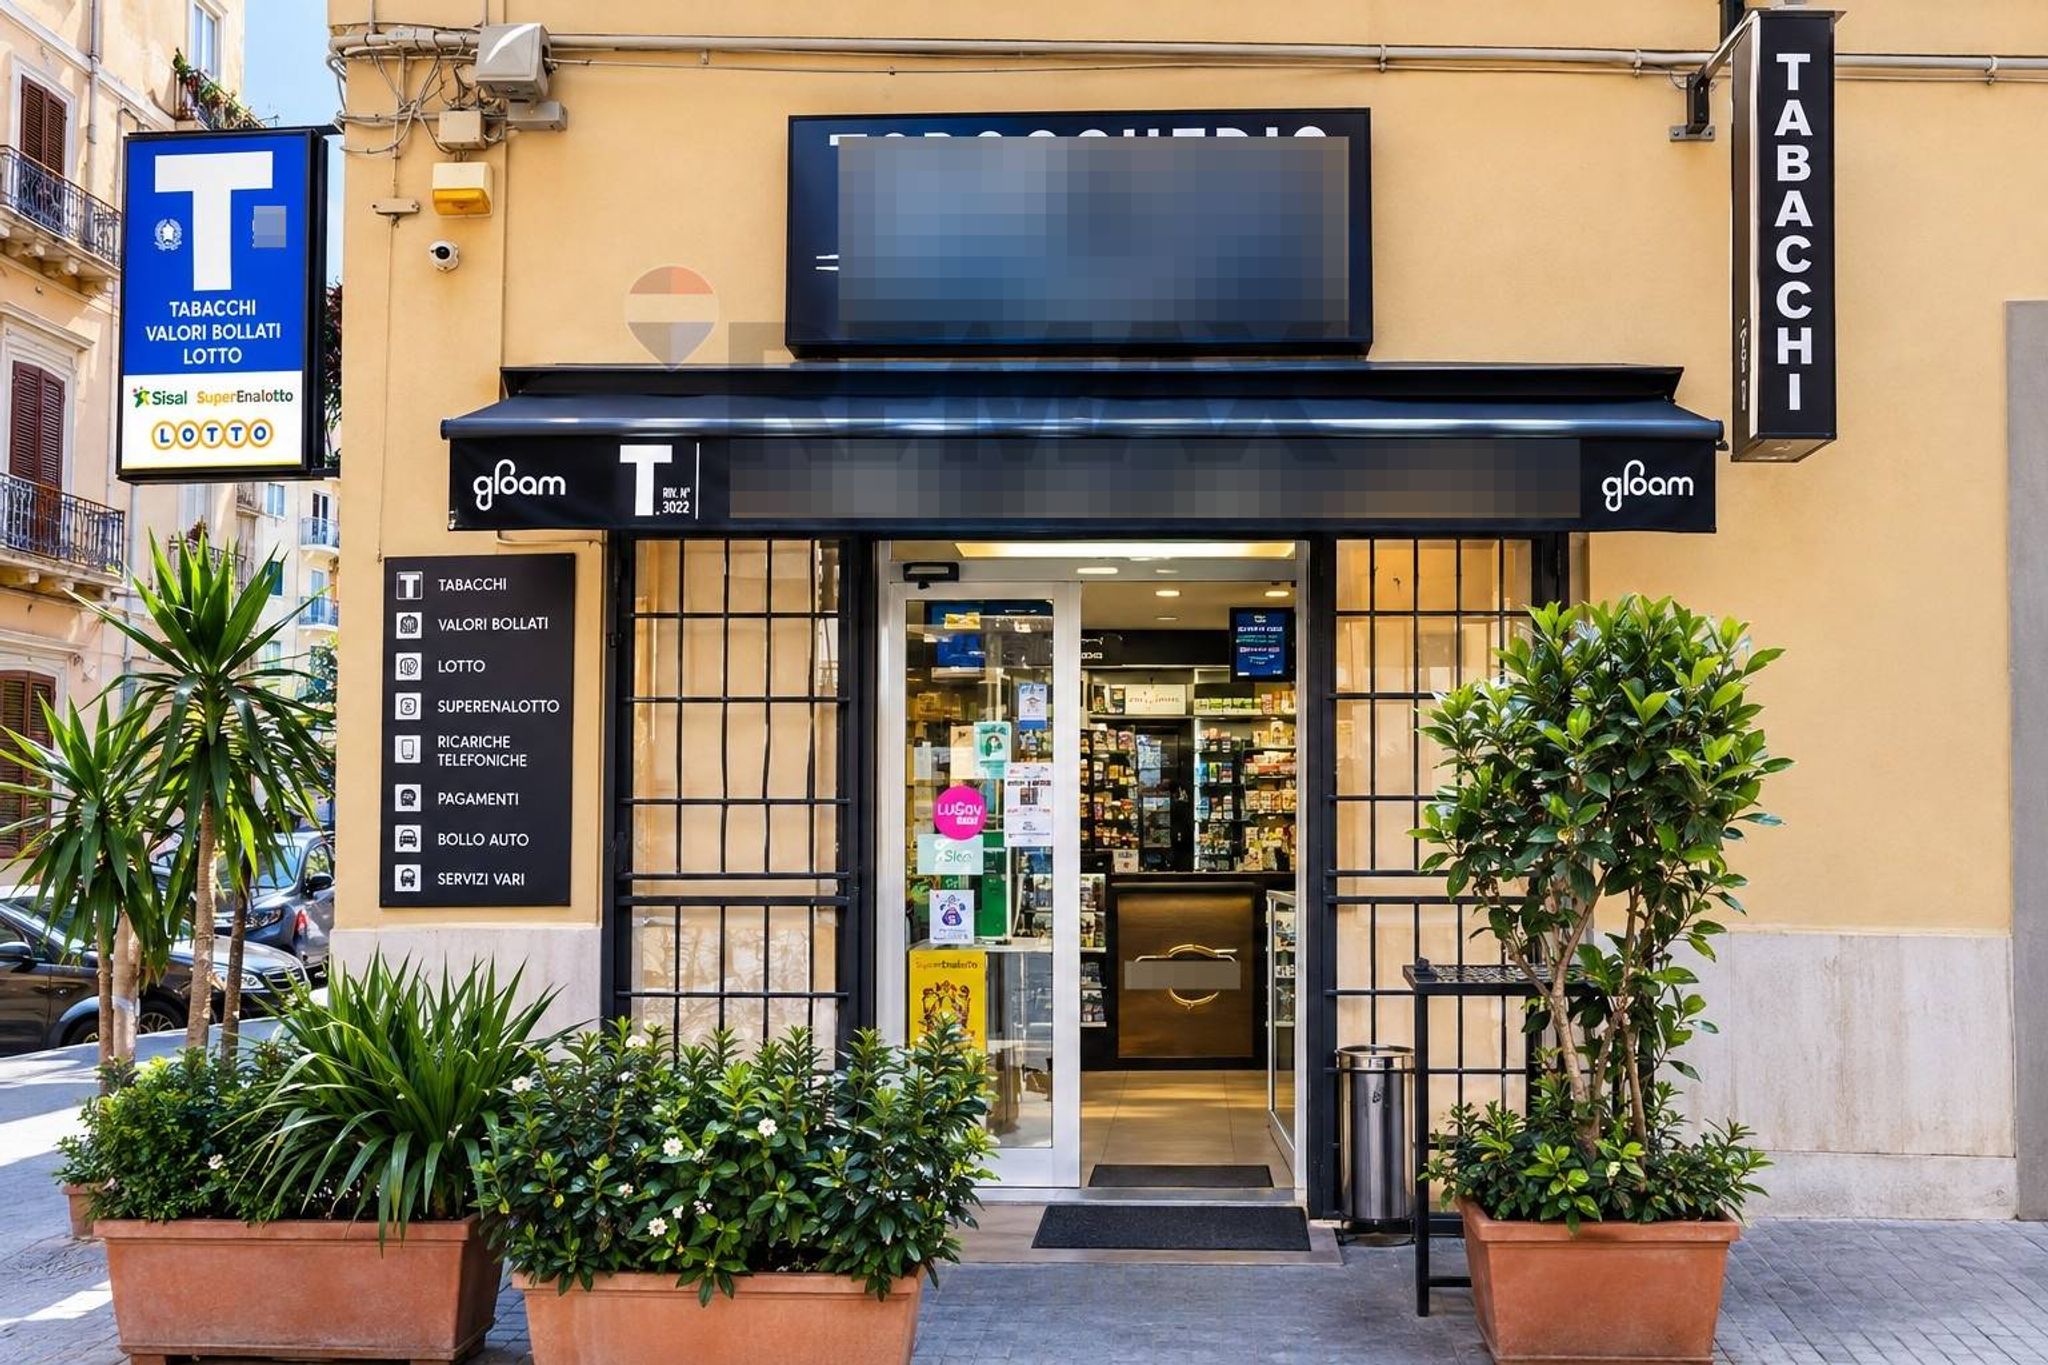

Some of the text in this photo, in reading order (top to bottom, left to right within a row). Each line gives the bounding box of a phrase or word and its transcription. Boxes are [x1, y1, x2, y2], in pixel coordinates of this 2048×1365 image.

[154, 150, 274, 291] T
[1774, 53, 1813, 411] TABACCHI
[169, 299, 256, 317] TABACCHI
[146, 322, 281, 342] VALORI BOLLATI
[183, 347, 243, 364] LOTTO
[152, 389, 294, 406] Sisal SuperEnalotto
[157, 423, 268, 446] LOTTO
[662, 500, 690, 514] 3022
[438, 578, 507, 592] TABACCHI
[438, 617, 549, 631] VALORI BOLLATI
[438, 660, 486, 673] LOTTO
[438, 700, 560, 713] SUPERENALOTTO
[438, 736, 511, 749] RICARICHE
[438, 754, 528, 767] TELEFONICHE
[438, 793, 519, 806] PAGAMENTI
[438, 833, 530, 847] BOLLO AUTO
[438, 873, 525, 886] SERVIZI VARI
